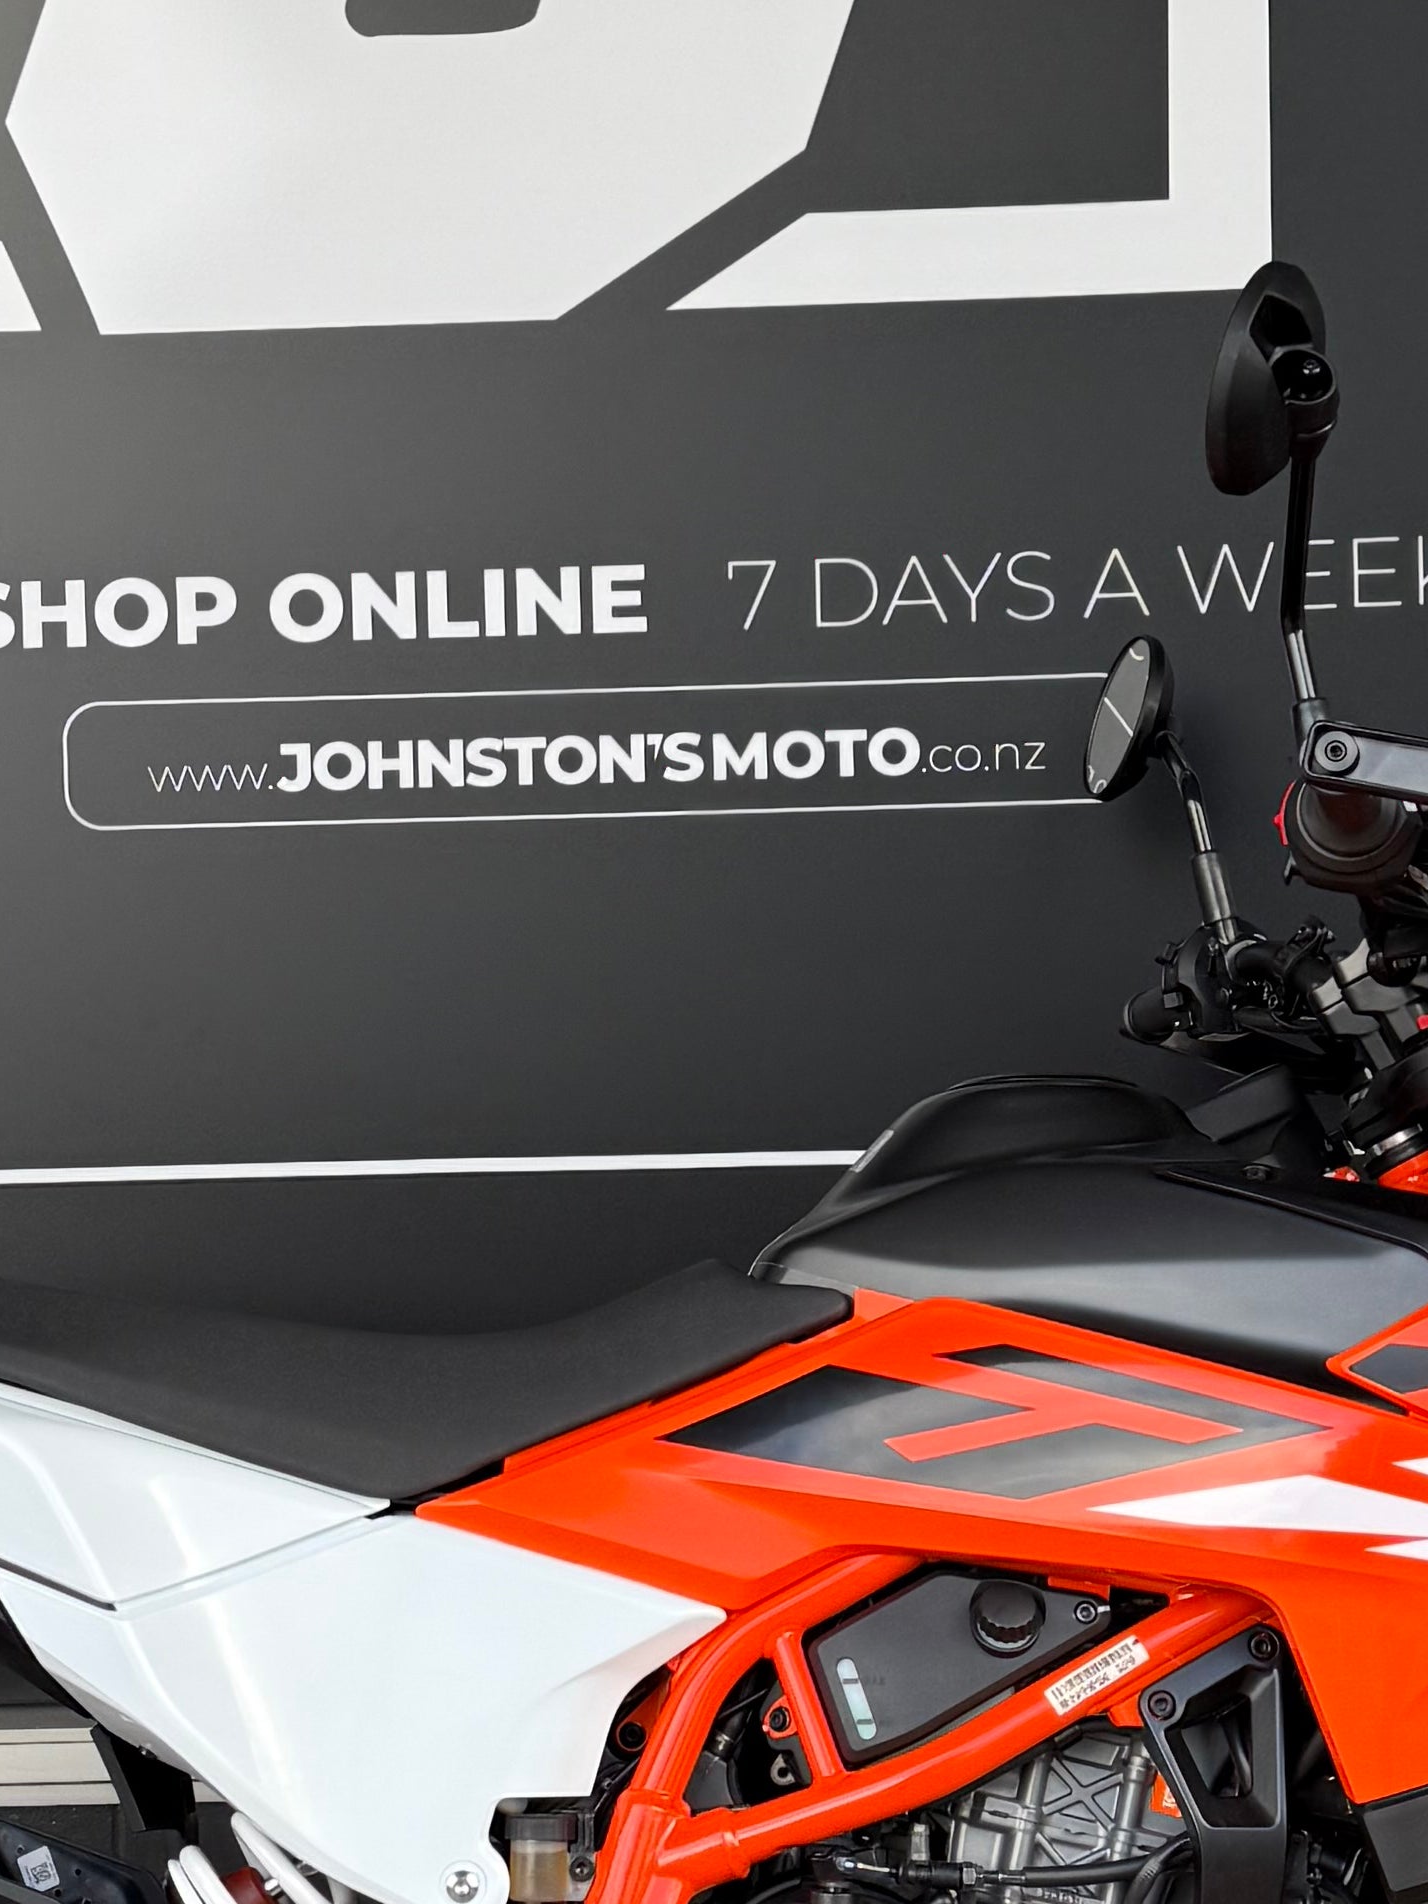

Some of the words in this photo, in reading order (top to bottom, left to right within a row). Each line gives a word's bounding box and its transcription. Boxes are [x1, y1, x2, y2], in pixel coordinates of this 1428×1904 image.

[268, 563, 648, 644] ONLINE
[727, 559, 777, 631] 7
[814, 550, 1055, 628] DAYS
[1083, 547, 1150, 619] A
